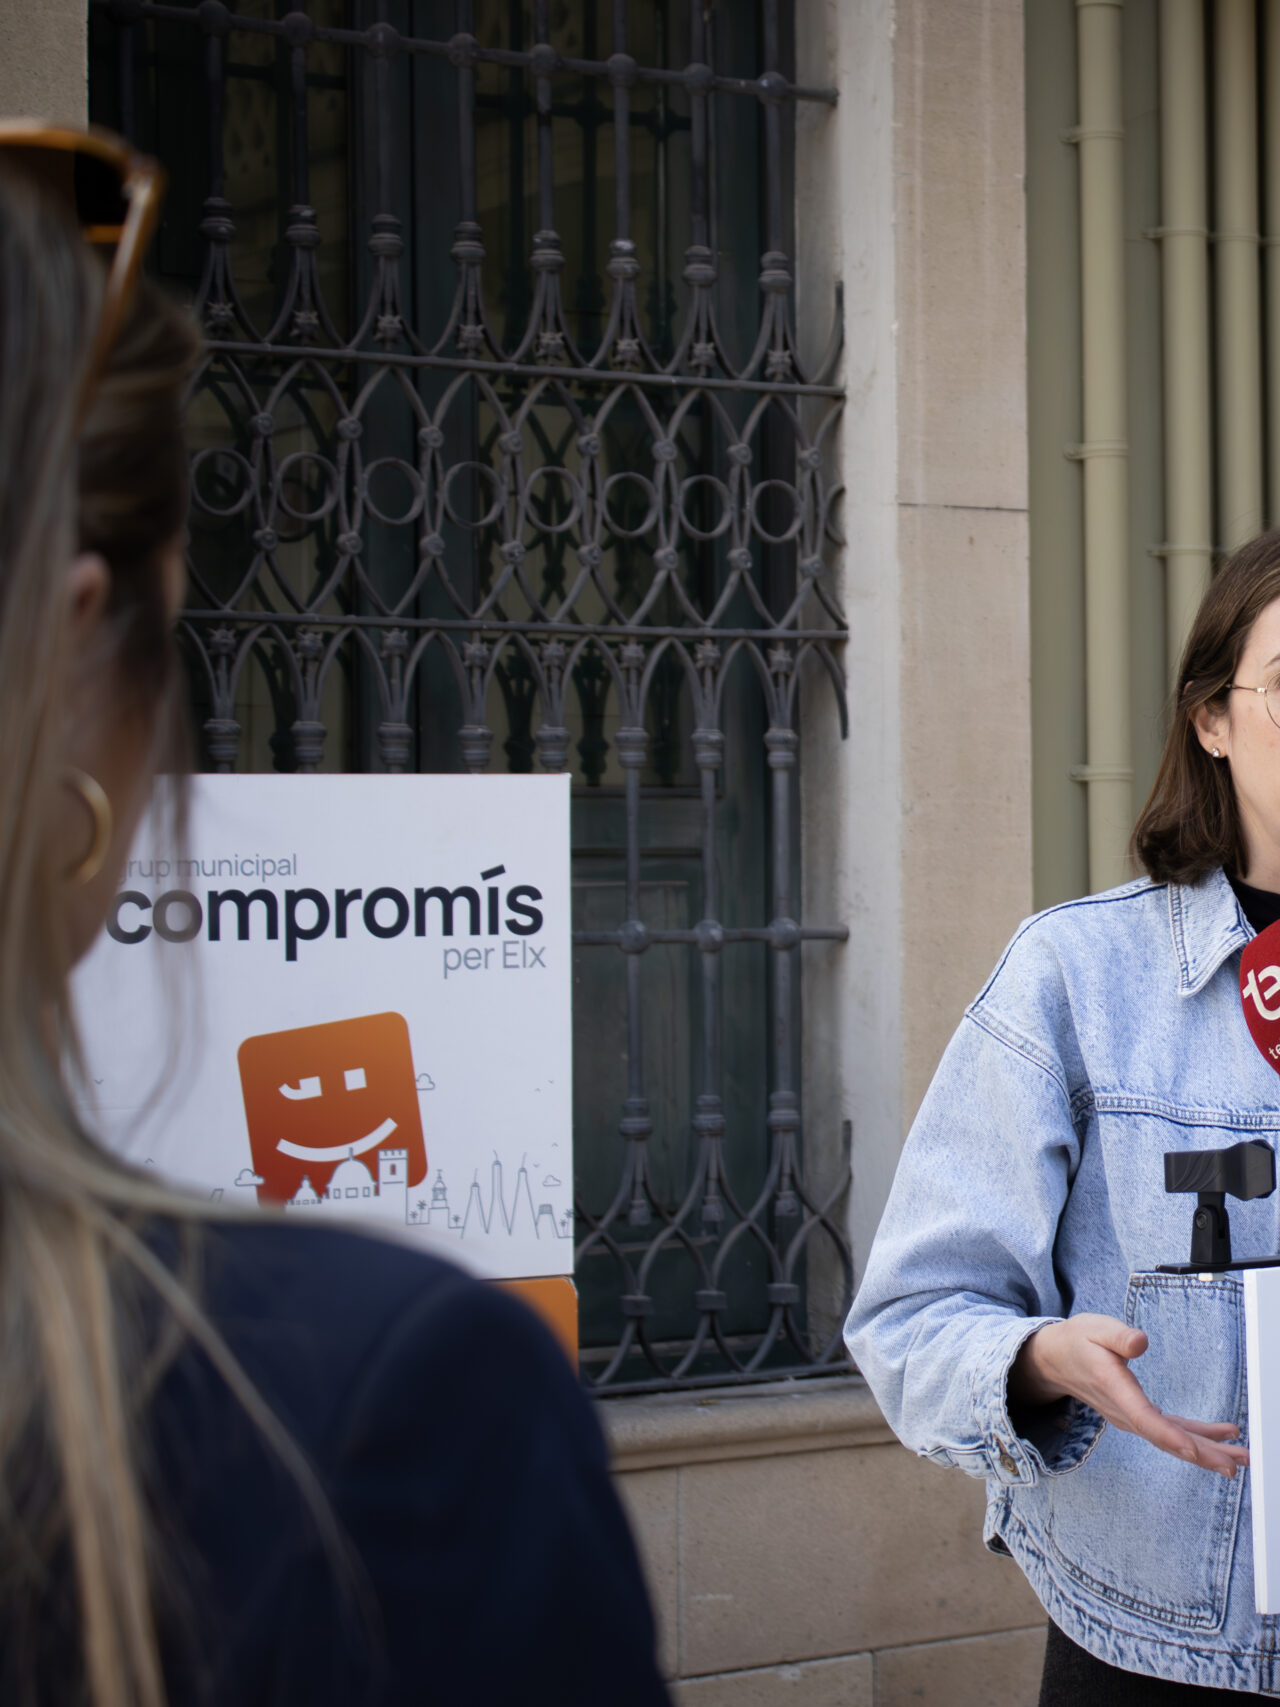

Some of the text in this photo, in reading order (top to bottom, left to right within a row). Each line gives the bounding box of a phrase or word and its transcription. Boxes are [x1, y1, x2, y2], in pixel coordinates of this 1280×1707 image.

[176, 854, 298, 883] municipal
[105, 864, 544, 962] compromís
[443, 940, 547, 979] per Elx
